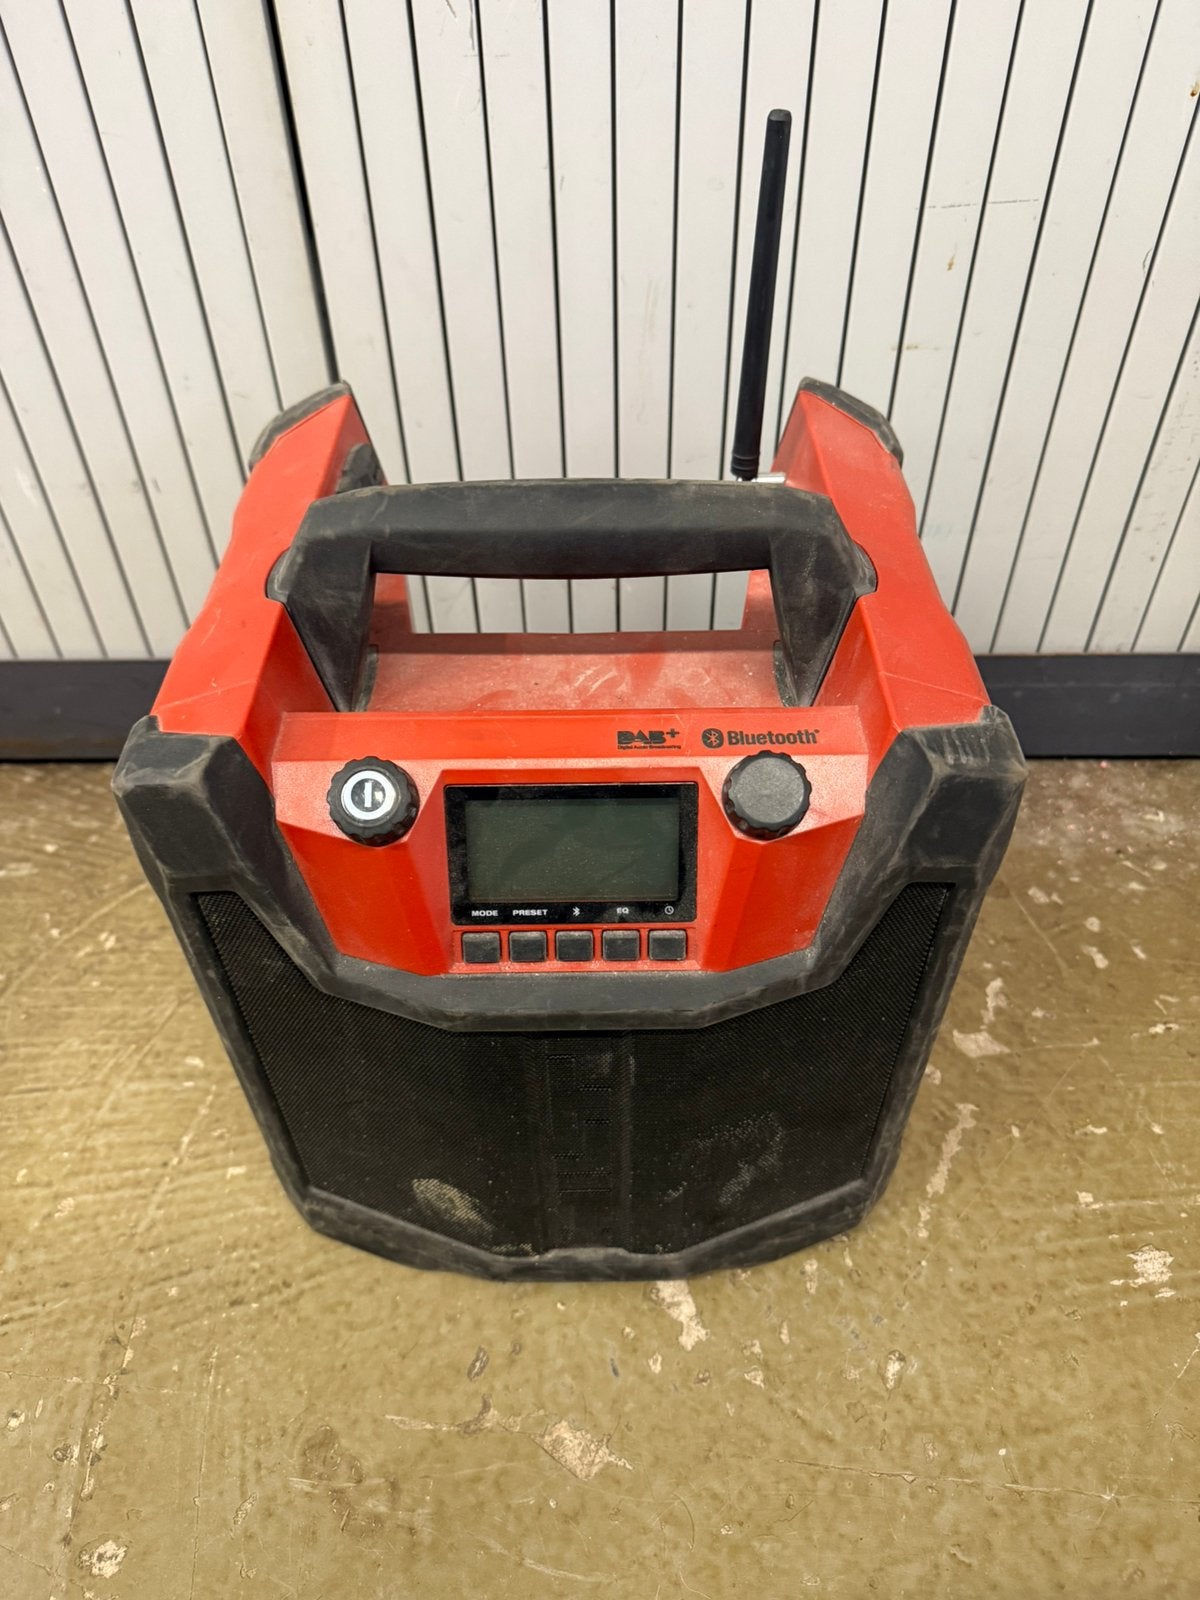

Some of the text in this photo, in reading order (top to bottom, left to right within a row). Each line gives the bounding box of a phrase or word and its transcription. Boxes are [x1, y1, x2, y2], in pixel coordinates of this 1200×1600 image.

[727, 729, 818, 746] Bluetooth
[471, 909, 498, 917] MODE
[512, 908, 548, 916] PRESET
[616, 907, 630, 915] EQ
